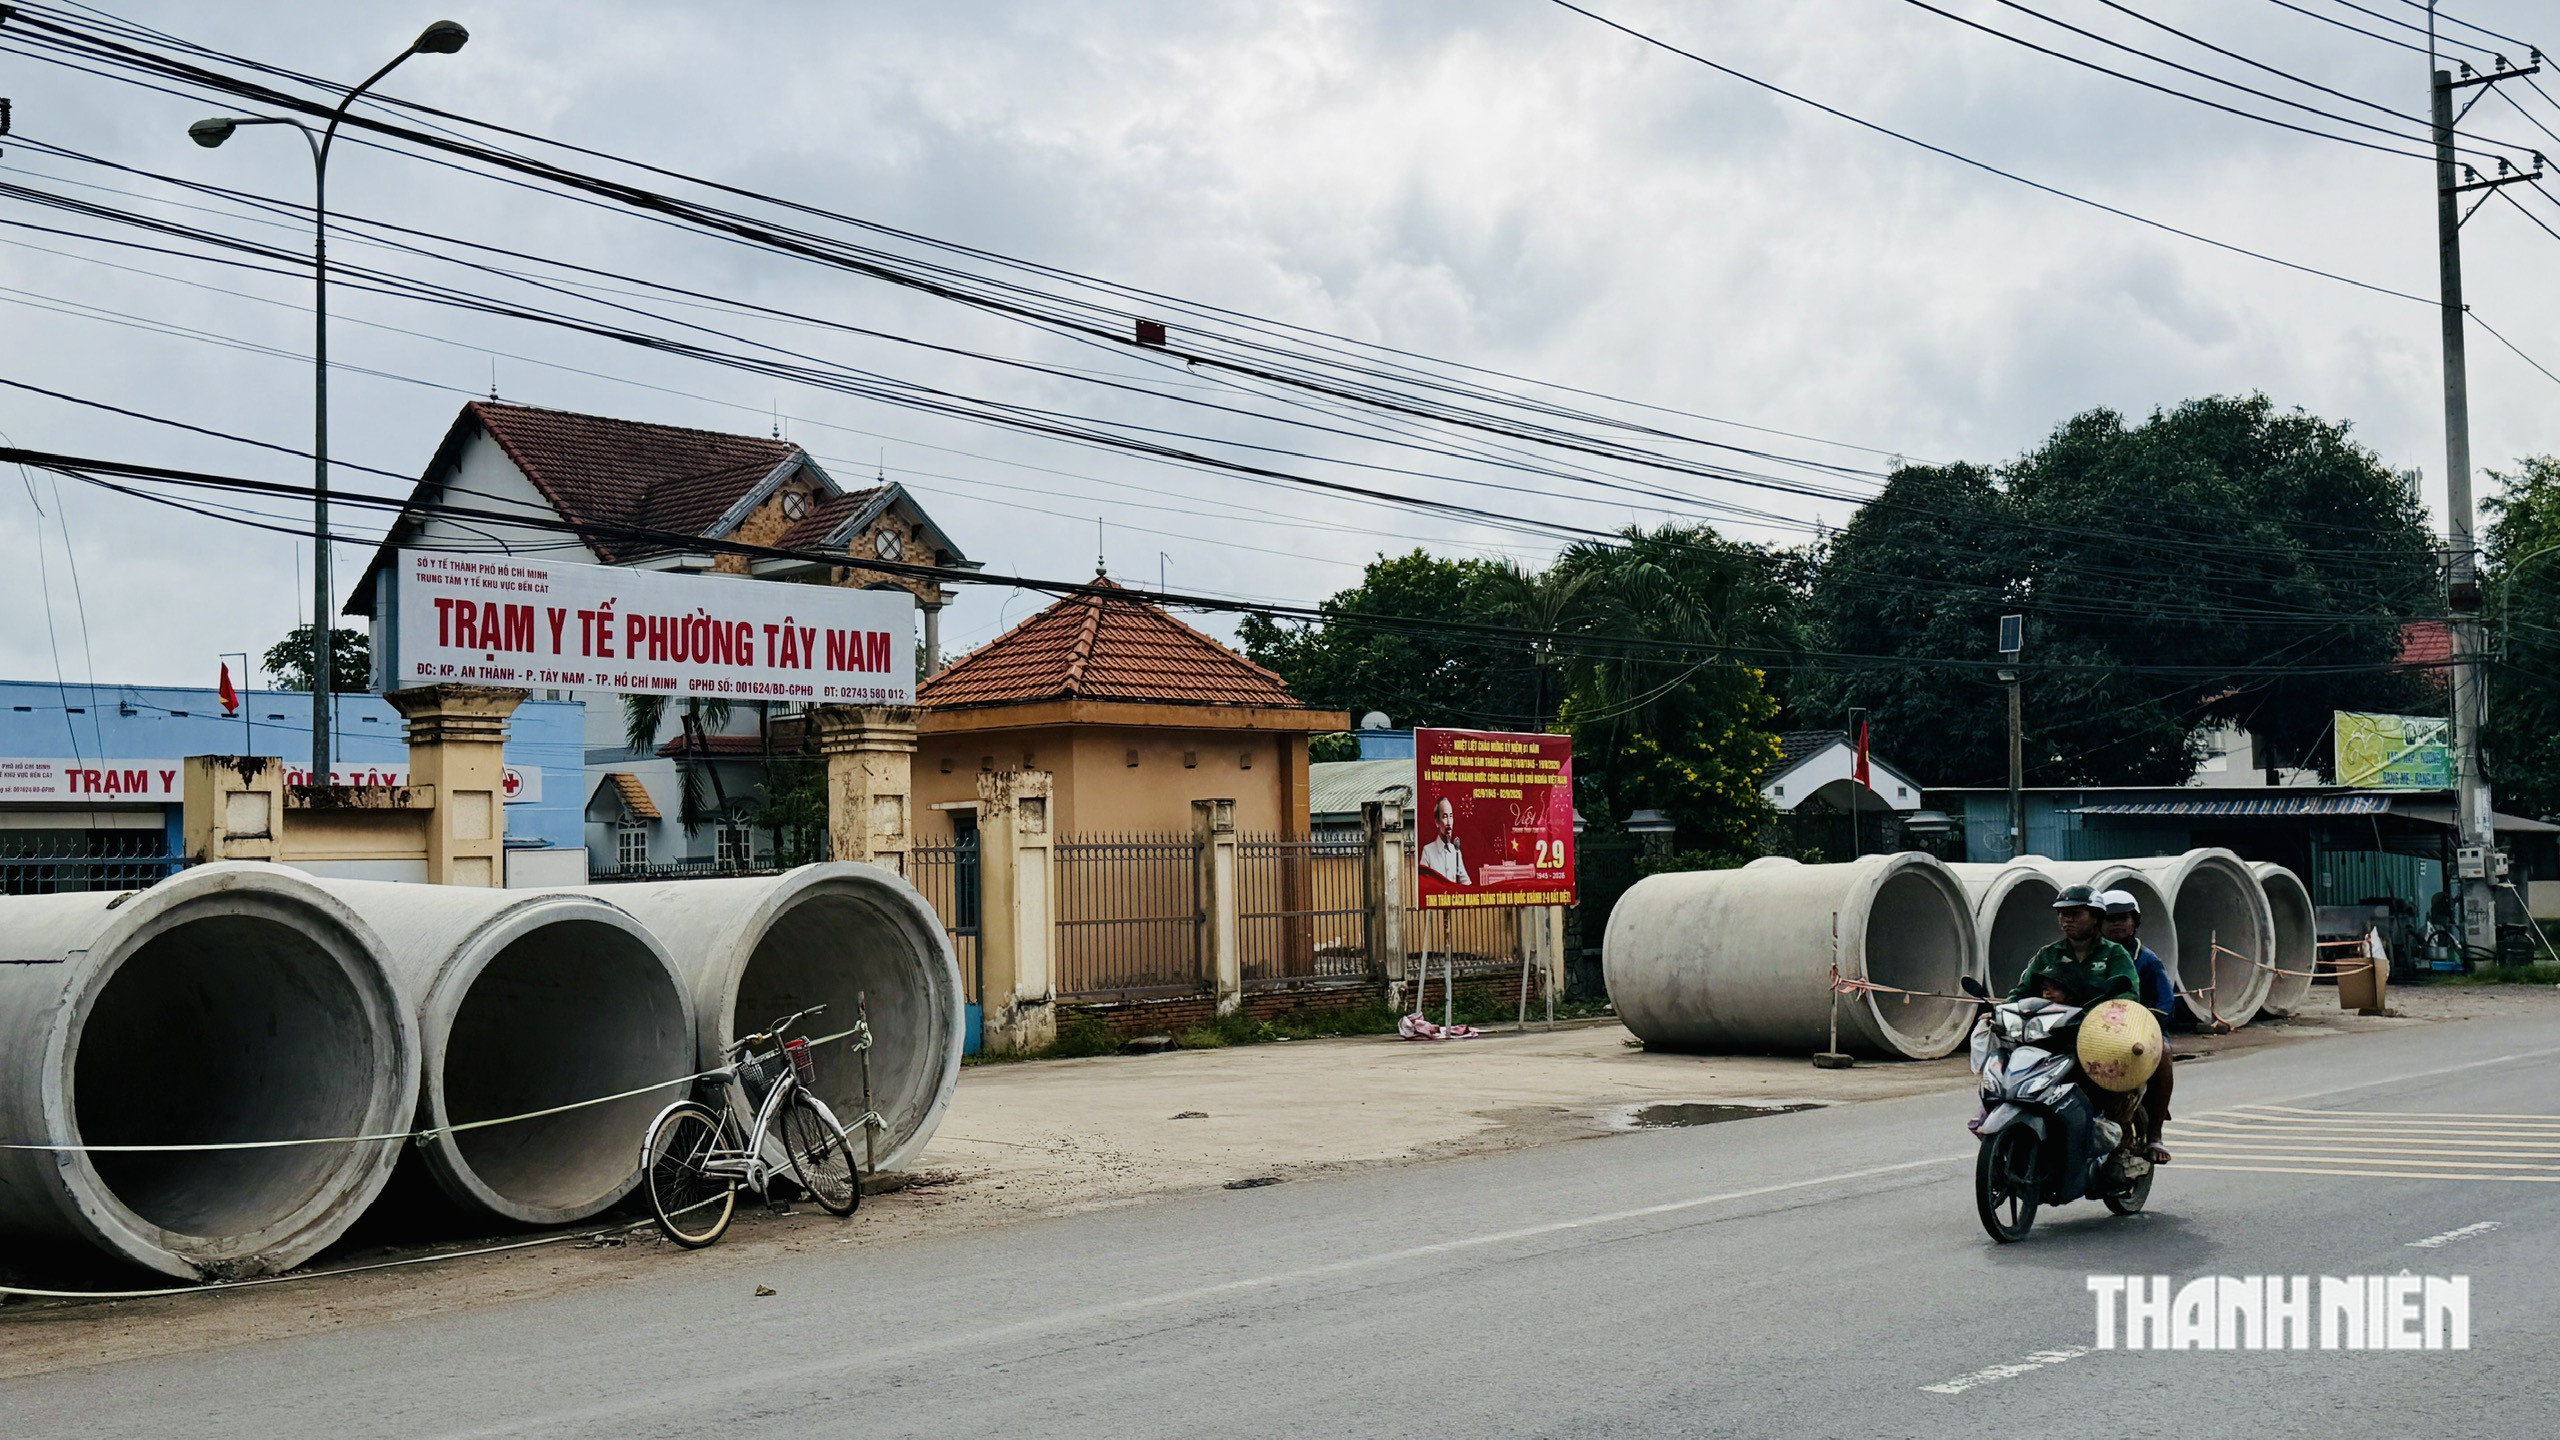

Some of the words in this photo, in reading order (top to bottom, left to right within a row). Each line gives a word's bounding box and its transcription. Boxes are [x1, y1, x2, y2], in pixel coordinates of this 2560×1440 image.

[416, 573, 442, 584] TRUNG
[445, 574, 462, 586] TÂM
[464, 577, 469, 586] Y
[471, 575, 481, 587] TẾ
[483, 579, 498, 589] KHU
[500, 581, 515, 592] VỰC
[518, 580, 533, 592] BẾN
[534, 582, 549, 593] CÁT
[417, 556, 428, 568] SỞ
[431, 559, 436, 568] Y
[438, 557, 448, 569] TẾ
[450, 560, 477, 573] THÀNH
[479, 562, 496, 575] PHỐ
[498, 564, 509, 577] HỒ
[511, 566, 525, 578] CHÍ
[527, 570, 548, 580] MINH
[434, 598, 534, 662] TRẠM
[547, 607, 567, 655] Y
[578, 597, 617, 659] TẾ
[627, 607, 754, 667] PHƯỜNG
[763, 616, 817, 670] TÂY
[826, 629, 891, 674] NAM
[417, 662, 436, 677] ĐC:
[440, 664, 458, 678] KP.
[461, 666, 476, 679] AN
[479, 664, 515, 680] THÀNH
[526, 670, 537, 682] P.
[540, 668, 559, 683] TÂY
[562, 672, 585, 685] NAM
[595, 674, 611, 687] TP.
[614, 671, 628, 688] HỒ
[631, 673, 649, 689] CHÍ
[652, 676, 677, 690] MINH
[689, 679, 715, 692] GPHĐ
[718, 676, 733, 693] SỐ:
[735, 681, 814, 697] 001624/BD-GPHĐ
[824, 686, 839, 698] ĐT:
[841, 686, 868, 699] 02743
[869, 687, 887, 700] 580
[888, 688, 905, 700] 012
[65, 769, 148, 799] TRẠM
[159, 770, 177, 793] Y
[1535, 839, 1565, 869] 2.9
